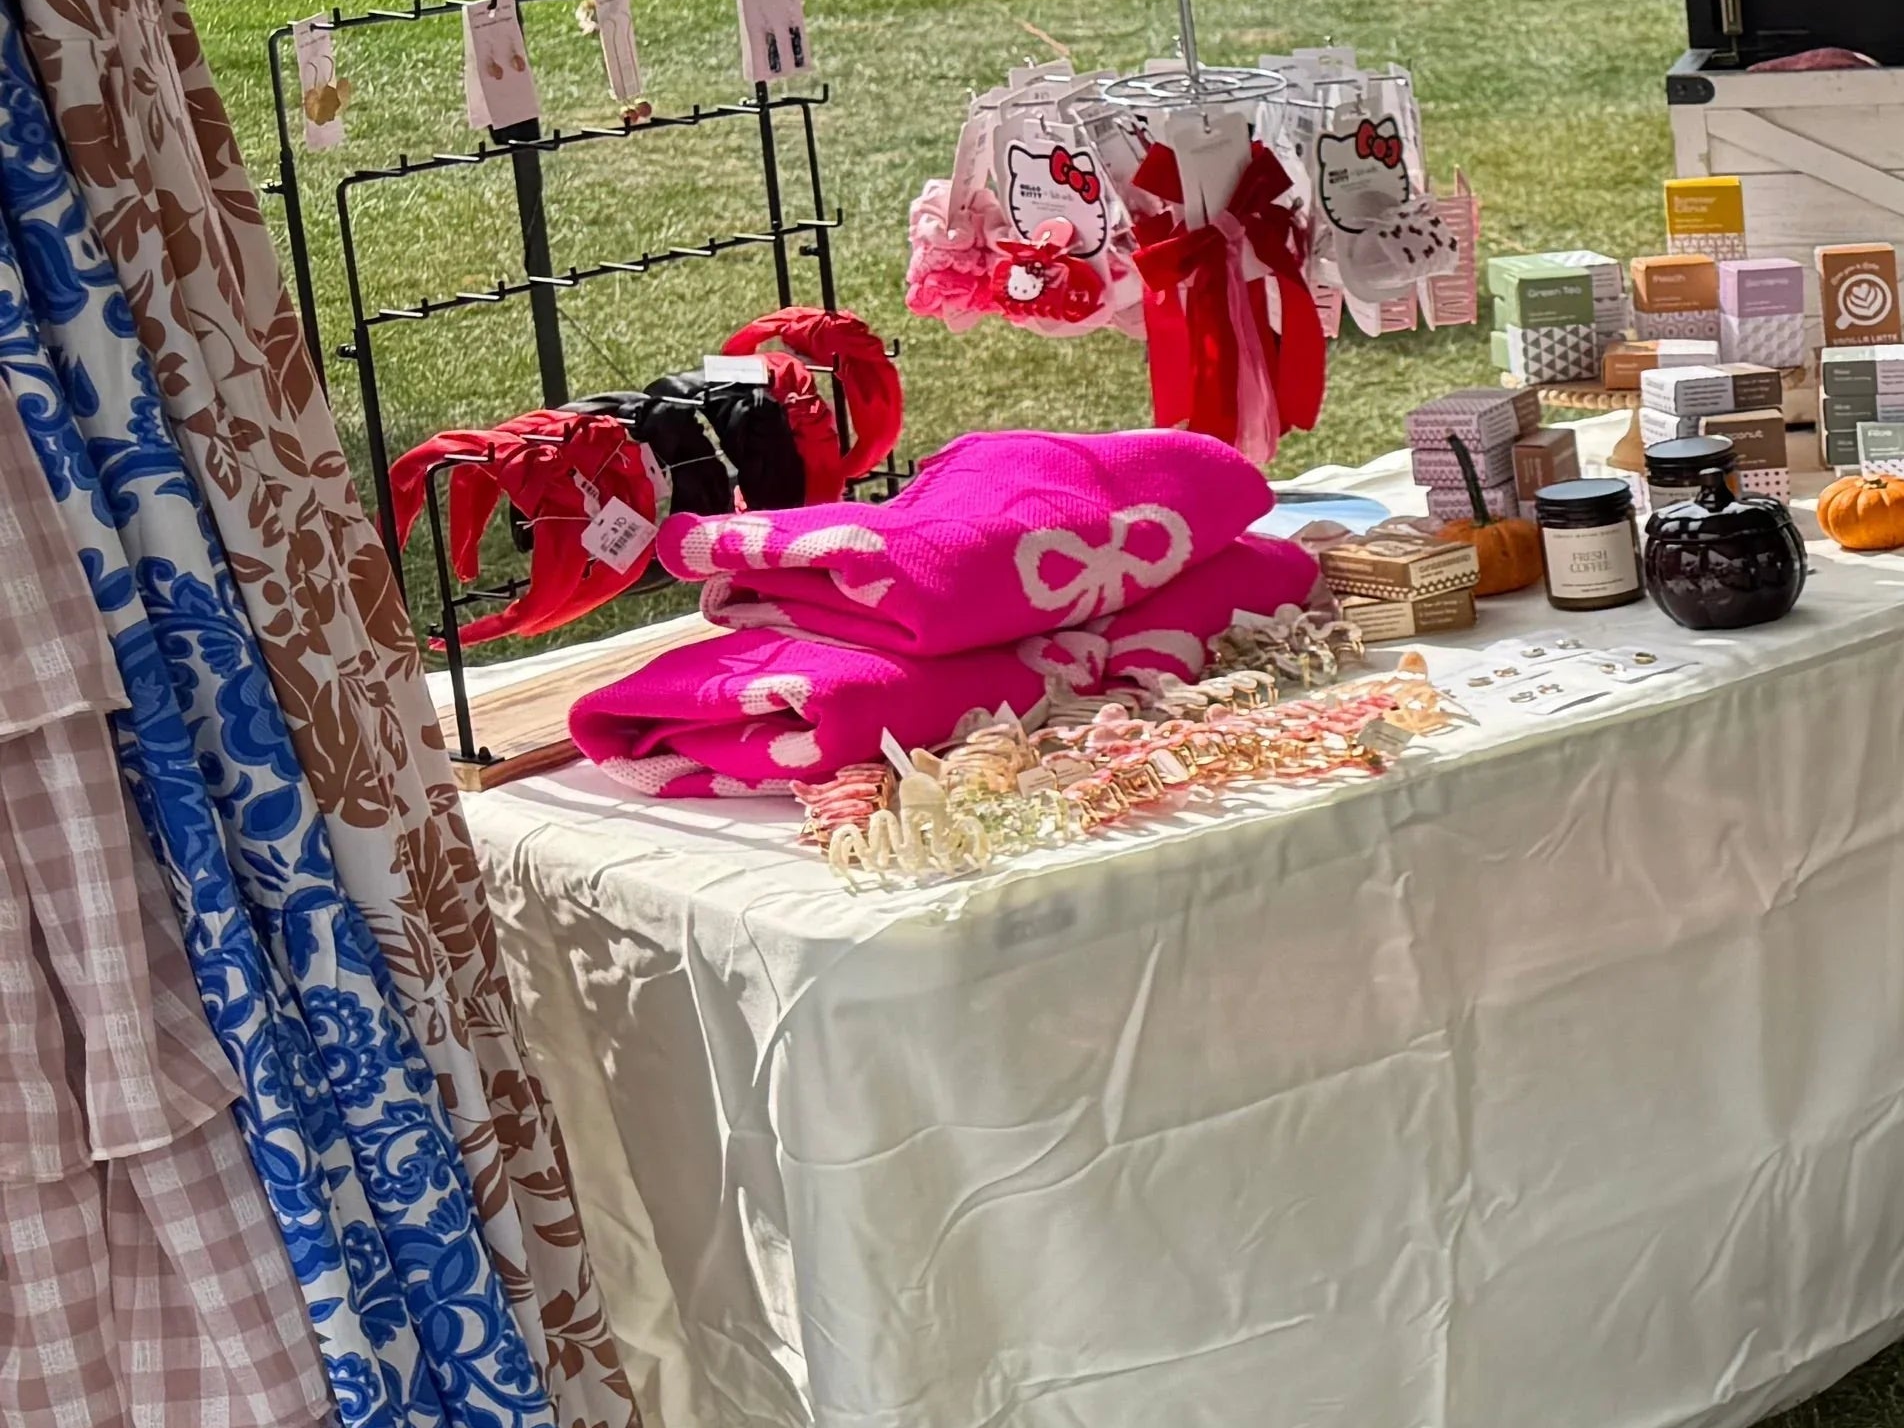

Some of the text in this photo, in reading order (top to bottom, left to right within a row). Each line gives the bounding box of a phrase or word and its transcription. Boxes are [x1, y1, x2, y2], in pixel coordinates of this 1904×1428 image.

[1526, 287, 1560, 300] Green
[1571, 549, 1608, 561] FRESH
[1569, 561, 1611, 574] COFFEE
